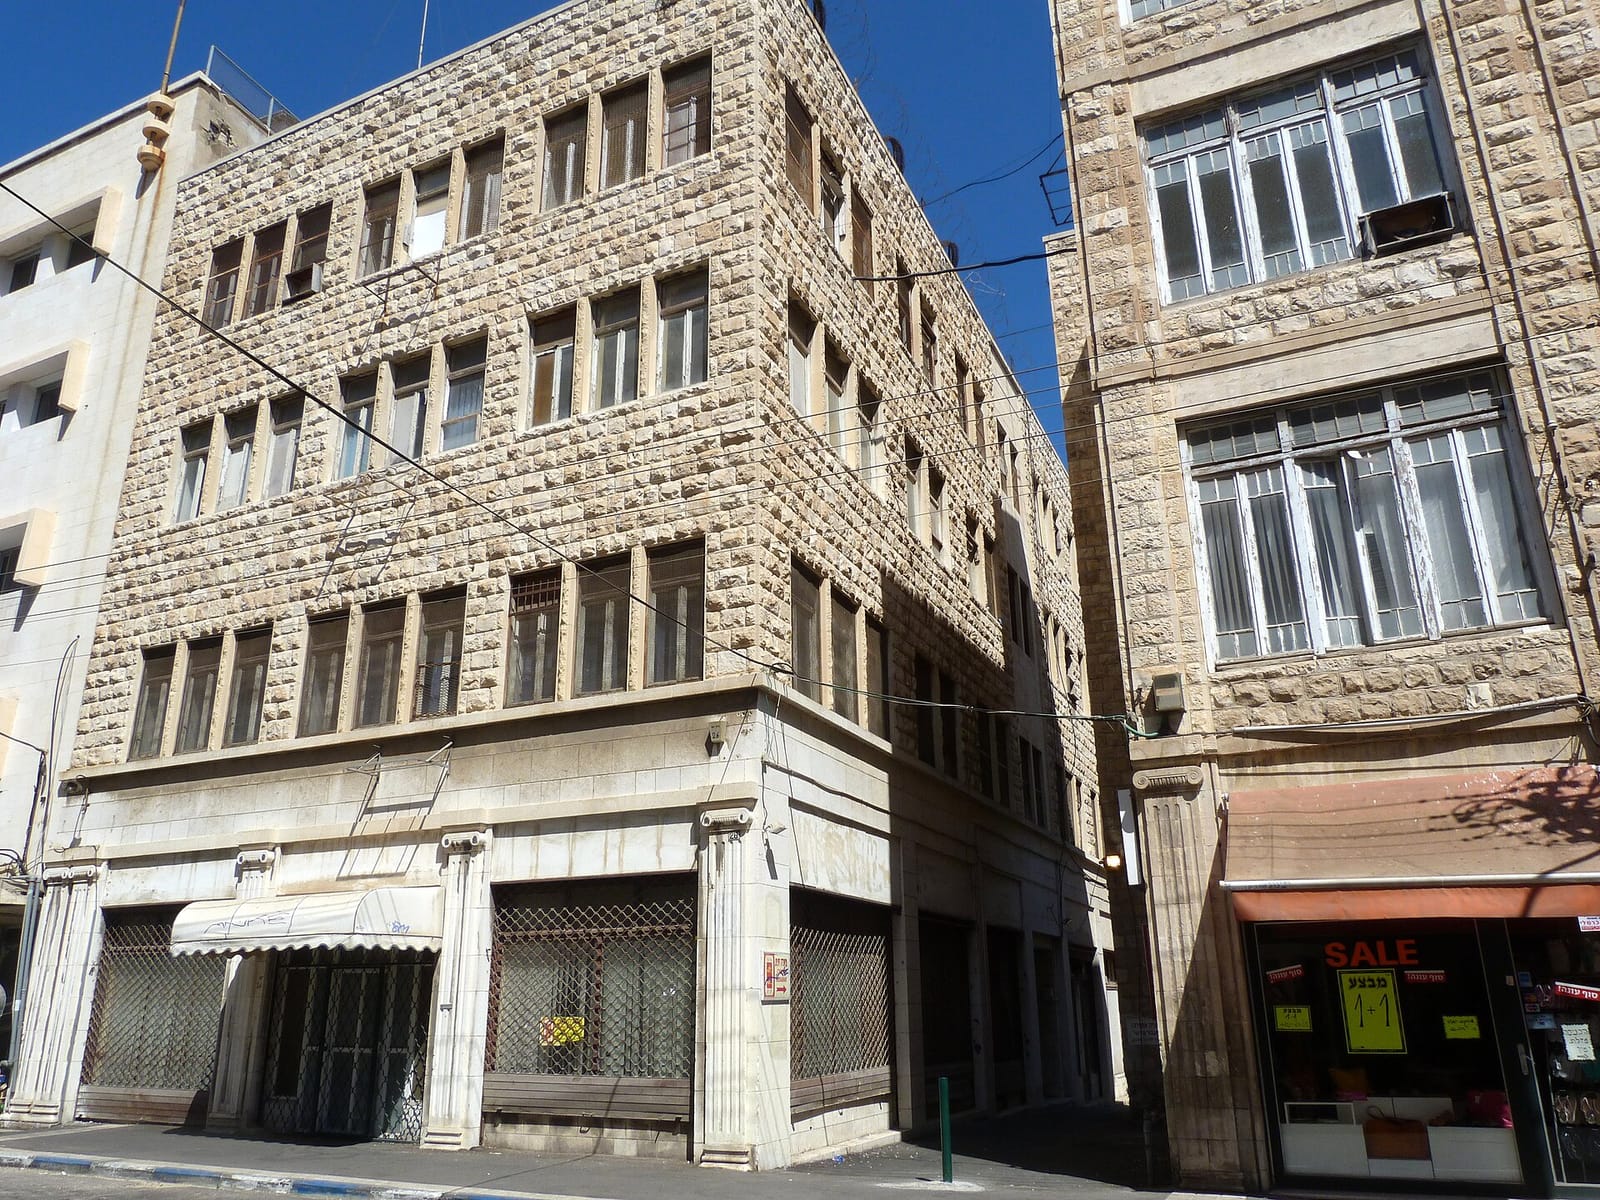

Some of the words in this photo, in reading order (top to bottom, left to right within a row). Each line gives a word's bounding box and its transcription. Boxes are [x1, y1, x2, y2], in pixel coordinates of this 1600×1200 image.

[1324, 940, 1419, 967] SALE
[1348, 976, 1387, 989] מבצע
[1429, 974, 1444, 982] סוף
[1582, 990, 1598, 999] סוף
